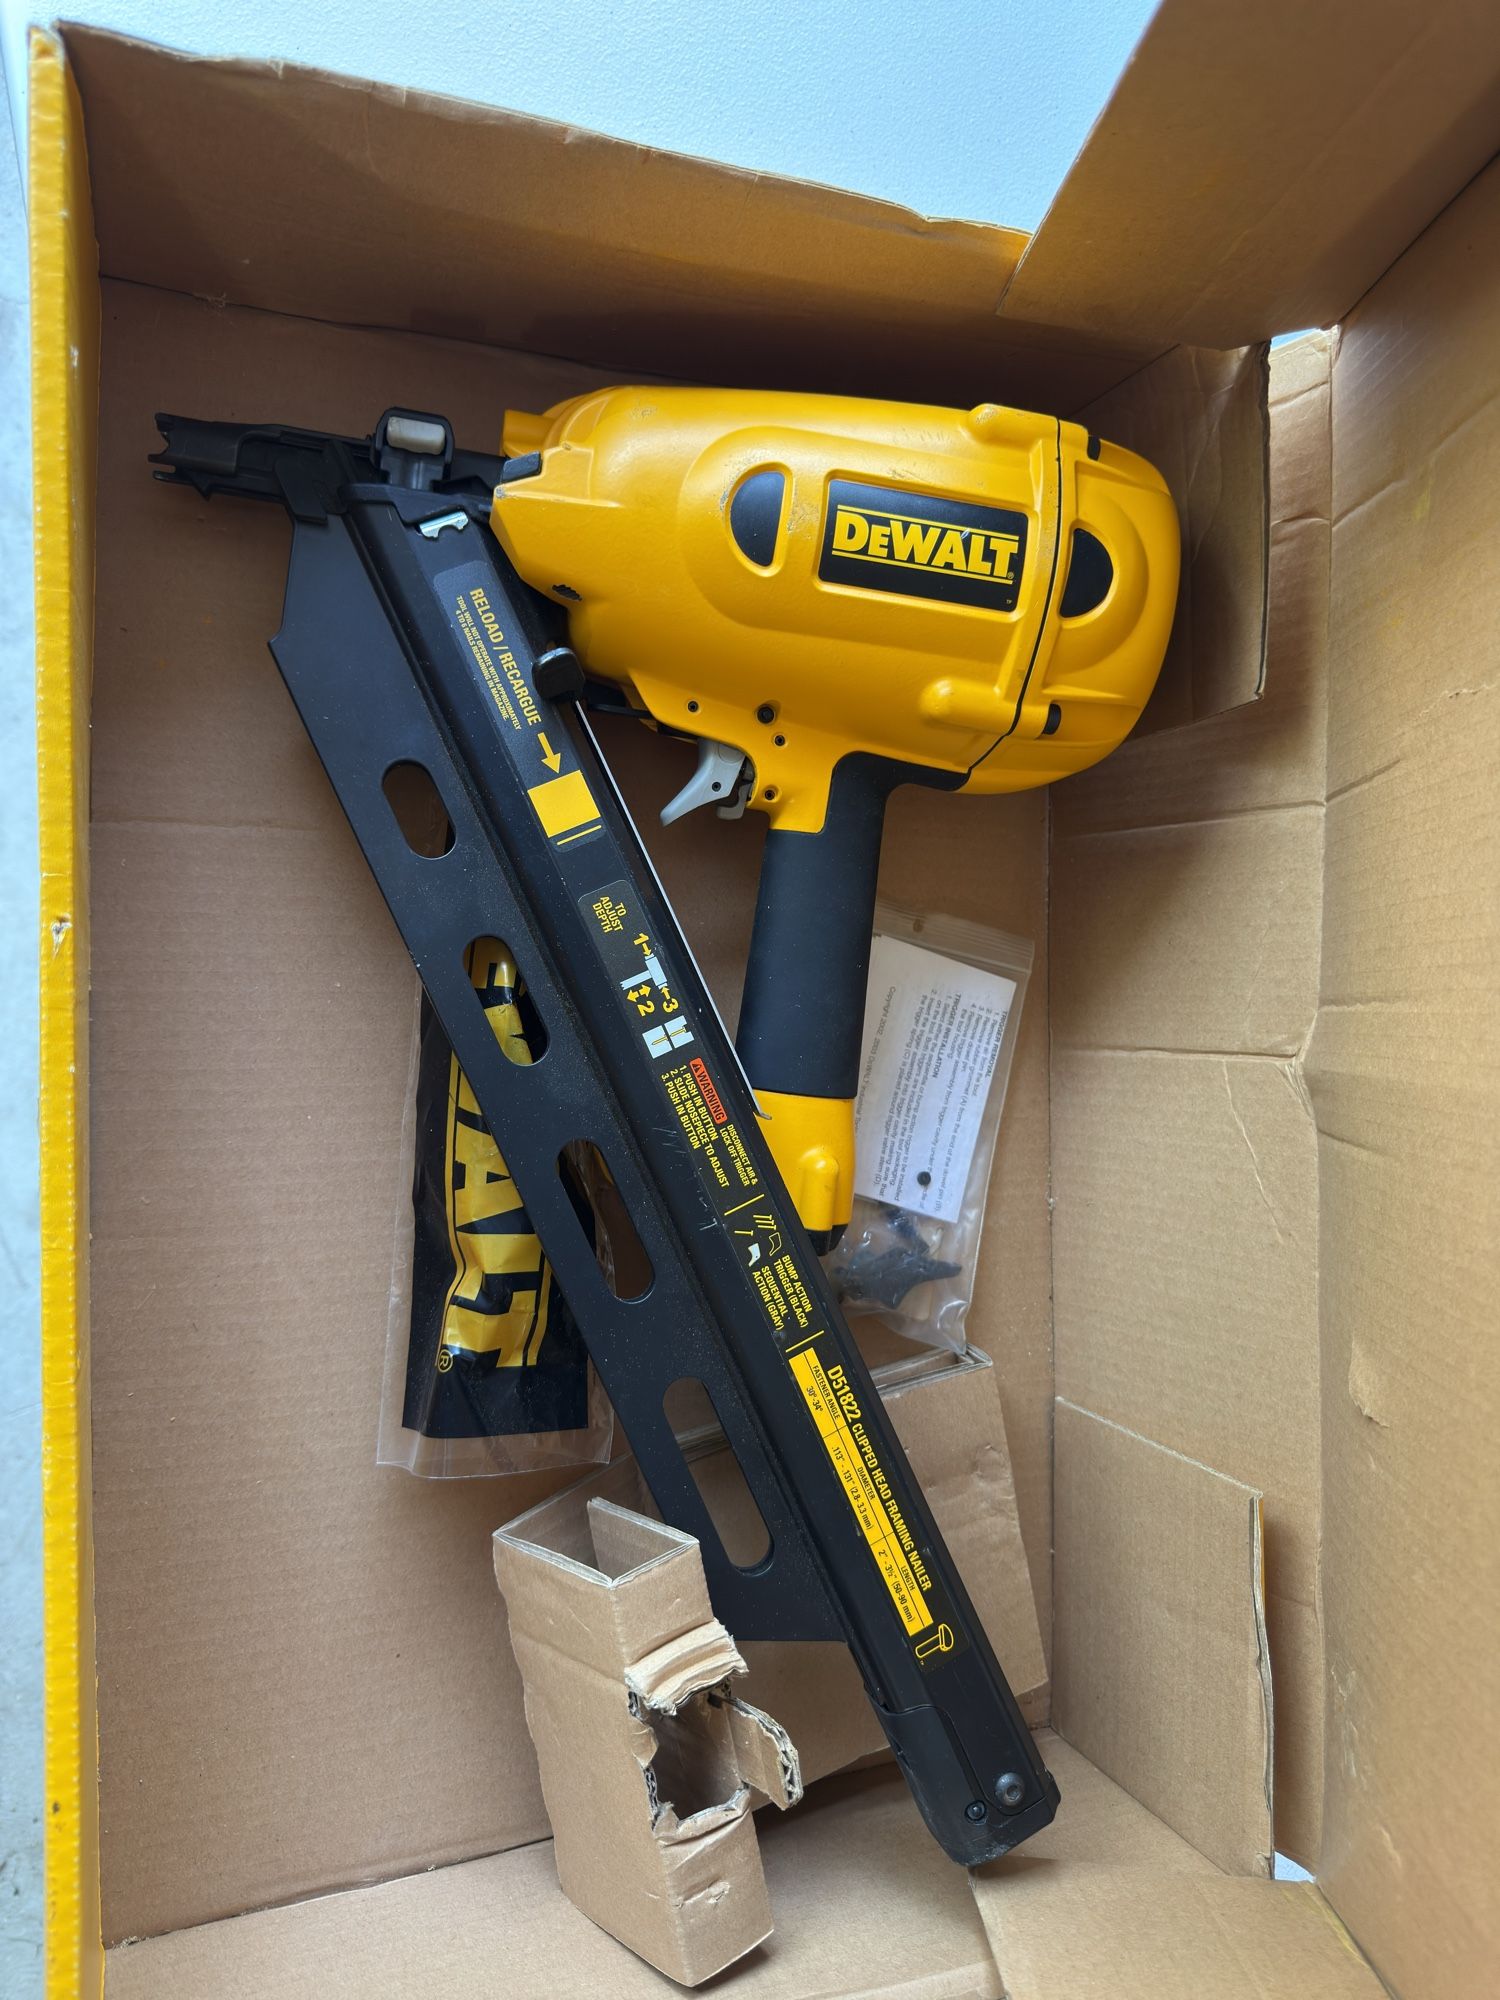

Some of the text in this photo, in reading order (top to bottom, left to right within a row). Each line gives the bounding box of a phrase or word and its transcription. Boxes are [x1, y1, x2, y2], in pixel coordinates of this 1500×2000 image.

[457, 596, 521, 729] TOOL WILL NOT OPERATE WITH APPROXIMATELY
[458, 614, 465, 623] TO
[463, 627, 475, 646] NAILS
[472, 646, 491, 680] REMAINING
[487, 680, 495, 688] IN
[491, 687, 509, 721] MAGAZINE.
[470, 588, 503, 643] RELOAD
[499, 652, 541, 726] RECARGUE
[593, 902, 613, 933] DEPTH
[600, 897, 623, 931] ADJUST
[615, 902, 626, 916] TO
[634, 933, 649, 945] 1
[637, 1001, 655, 1016] 2
[663, 998, 678, 1012] 3
[882, 986, 896, 1018] Copyright
[925, 997, 935, 1016] Insert
[936, 1000, 942, 1009] on
[914, 1006, 925, 1027] trigger
[921, 1017, 929, 1028] the
[932, 1010, 940, 1020] the
[940, 1003, 950, 1023] Select
[960, 1008, 968, 1019] the
[934, 1023, 943, 1042] either
[956, 1020, 964, 1033] tool
[962, 1011, 975, 1038] Remove
[970, 1014, 982, 1040] Remove
[978, 1016, 990, 1043] Remove
[986, 1019, 998, 1045] Remove
[906, 1028, 917, 1048] spring
[915, 1029, 925, 1050] trigger
[922, 1036, 932, 1052] Both
[932, 994, 961, 1078] TRIGGER INSTALLATION
[985, 1011, 1008, 1078] TRIGGER REMOVAL
[930, 1042, 938, 1053] the
[956, 1038, 966, 1059] trigger
[972, 1044, 981, 1065] rubber
[904, 1051, 918, 1082] assembly
[915, 1053, 927, 1077] triggers
[979, 1057, 987, 1071] from
[895, 1067, 905, 1090] placed
[947, 1060, 960, 1090] assembly
[964, 1066, 975, 1095] grommet
[695, 1071, 725, 1120] WARNING
[901, 1083, 909, 1096] into
[919, 1086, 924, 1094] or
[944, 1090, 952, 1105] from
[661, 1073, 701, 1149] 3. PUSH IN BUTTON
[680, 1065, 719, 1141] 1. PUSH IN BUTTON
[889, 1090, 899, 1114] around
[896, 1097, 906, 1118] trigger
[904, 1090, 915, 1118] included
[913, 1094, 924, 1113] bump
[960, 1096, 968, 1106] (A)
[909, 1114, 917, 1133] action
[938, 1106, 948, 1127] trigger
[956, 1107, 965, 1122] from
[670, 1069, 729, 1187] 2. SLIDE NOSEPIECE TO ADJUST
[884, 1115, 894, 1136] trigger
[890, 1120, 899, 1139] cavity
[727, 1124, 750, 1165] DISCONNECT
[746, 1167, 755, 1178] AIR
[884, 1140, 895, 1165] making
[898, 1138, 906, 1151] tool
[902, 1134, 913, 1155] trigger
[947, 1148, 952, 1156] of
[720, 1128, 750, 1186] LOCK OFF TRIGGER
[901, 1164, 907, 1173] be
[879, 1183, 887, 1196] that
[894, 1174, 905, 1201] installed
[761, 1266, 788, 1317] SEQUENTIAL
[774, 1259, 808, 1328] TRIGGER (BLACK)
[782, 1255, 812, 1312] BUMP ACTION
[752, 1271, 784, 1330] ACTION (GRAY)
[813, 1365, 840, 1420] FASTENER ANGLE
[827, 1365, 931, 1591] D51822 CLIPPED HEAD FRAMING NAILER
[857, 1467, 875, 1500] DIAMETER
[862, 1514, 874, 1530] mm)
[901, 1566, 915, 1591] LENGTH
[892, 1581, 907, 1605] (50-90
[903, 1605, 915, 1622] mm)
